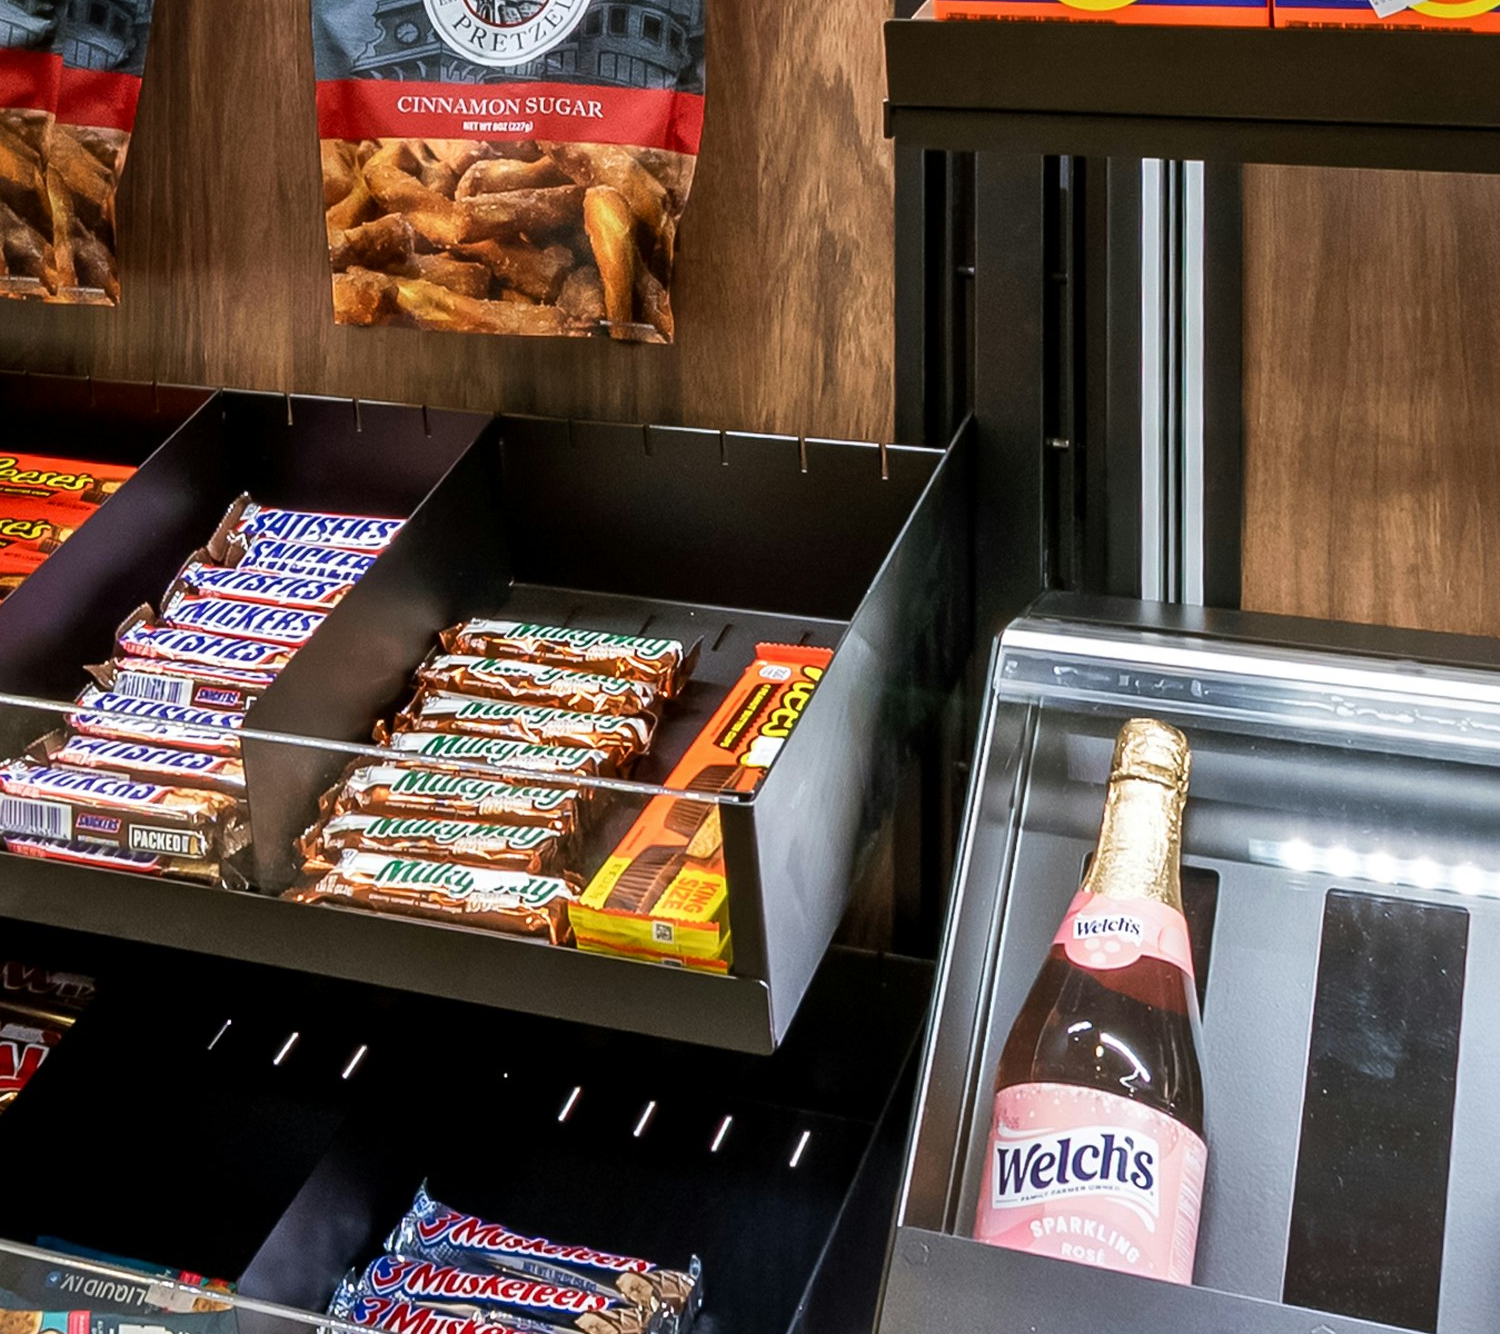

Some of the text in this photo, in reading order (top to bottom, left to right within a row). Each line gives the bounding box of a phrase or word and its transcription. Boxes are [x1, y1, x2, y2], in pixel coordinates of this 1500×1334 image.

[396, 95, 604, 119] CINNAMON SUGAR
[463, 121, 479, 131] NET
[480, 122, 492, 131] WT
[77, 816, 120, 831] SNICKERS
[132, 829, 182, 853] PACKED
[662, 877, 696, 911] SIZE
[682, 881, 720, 914] KING
[1076, 917, 1141, 937] Welch's
[997, 1133, 1156, 1196] Welch's
[1030, 1217, 1141, 1264] SPARKLING
[1060, 1242, 1105, 1263] ROSÉ
[84, 1281, 148, 1307] LIQUID
[406, 1262, 616, 1312] Musketeers
